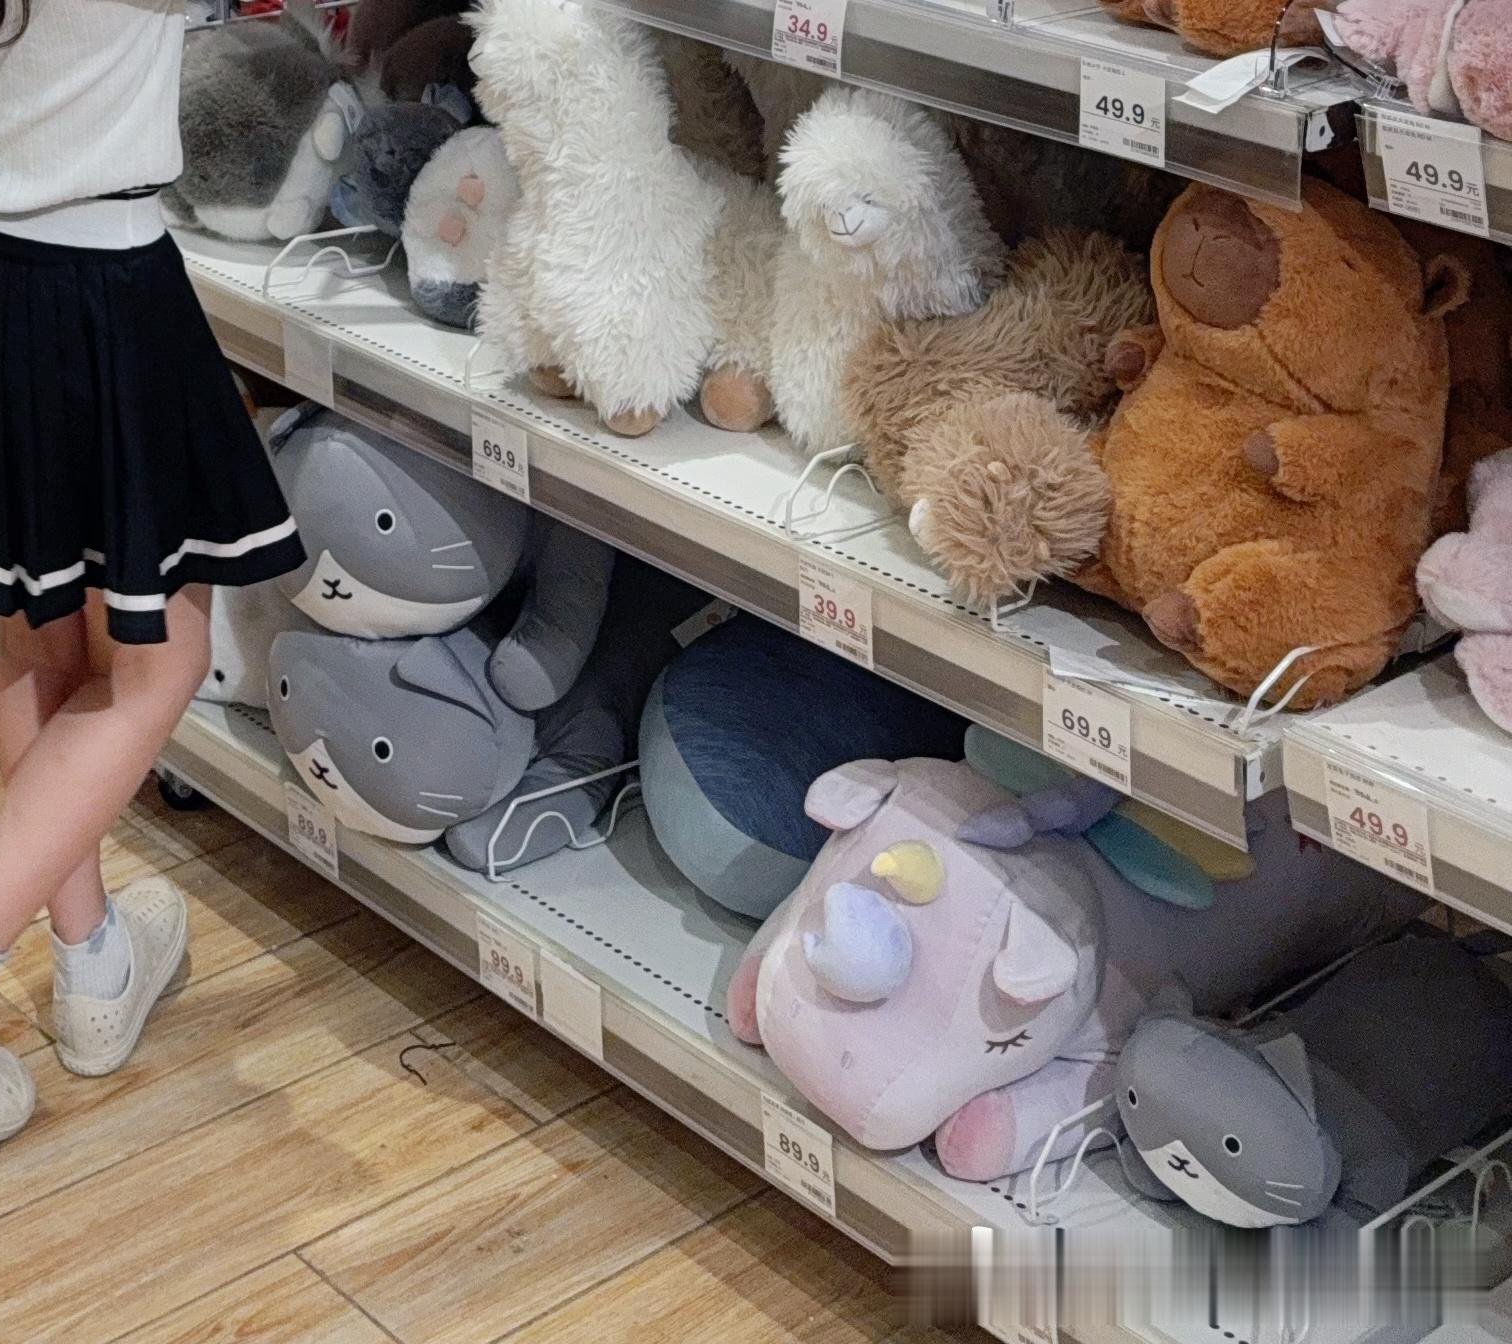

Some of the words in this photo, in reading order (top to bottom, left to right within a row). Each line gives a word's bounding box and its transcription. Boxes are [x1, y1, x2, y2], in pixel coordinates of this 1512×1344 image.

[788, 14, 828, 42] 34.9
[1095, 95, 1145, 125] 49.9
[1405, 160, 1464, 192] 49.9
[483, 439, 516, 469] 69.9
[814, 593, 856, 629] 39.9
[1061, 708, 1112, 749] 69.9
[1349, 806, 1409, 847] 49.9
[490, 949, 524, 985] 99.9
[779, 1132, 820, 1174] 89.9
